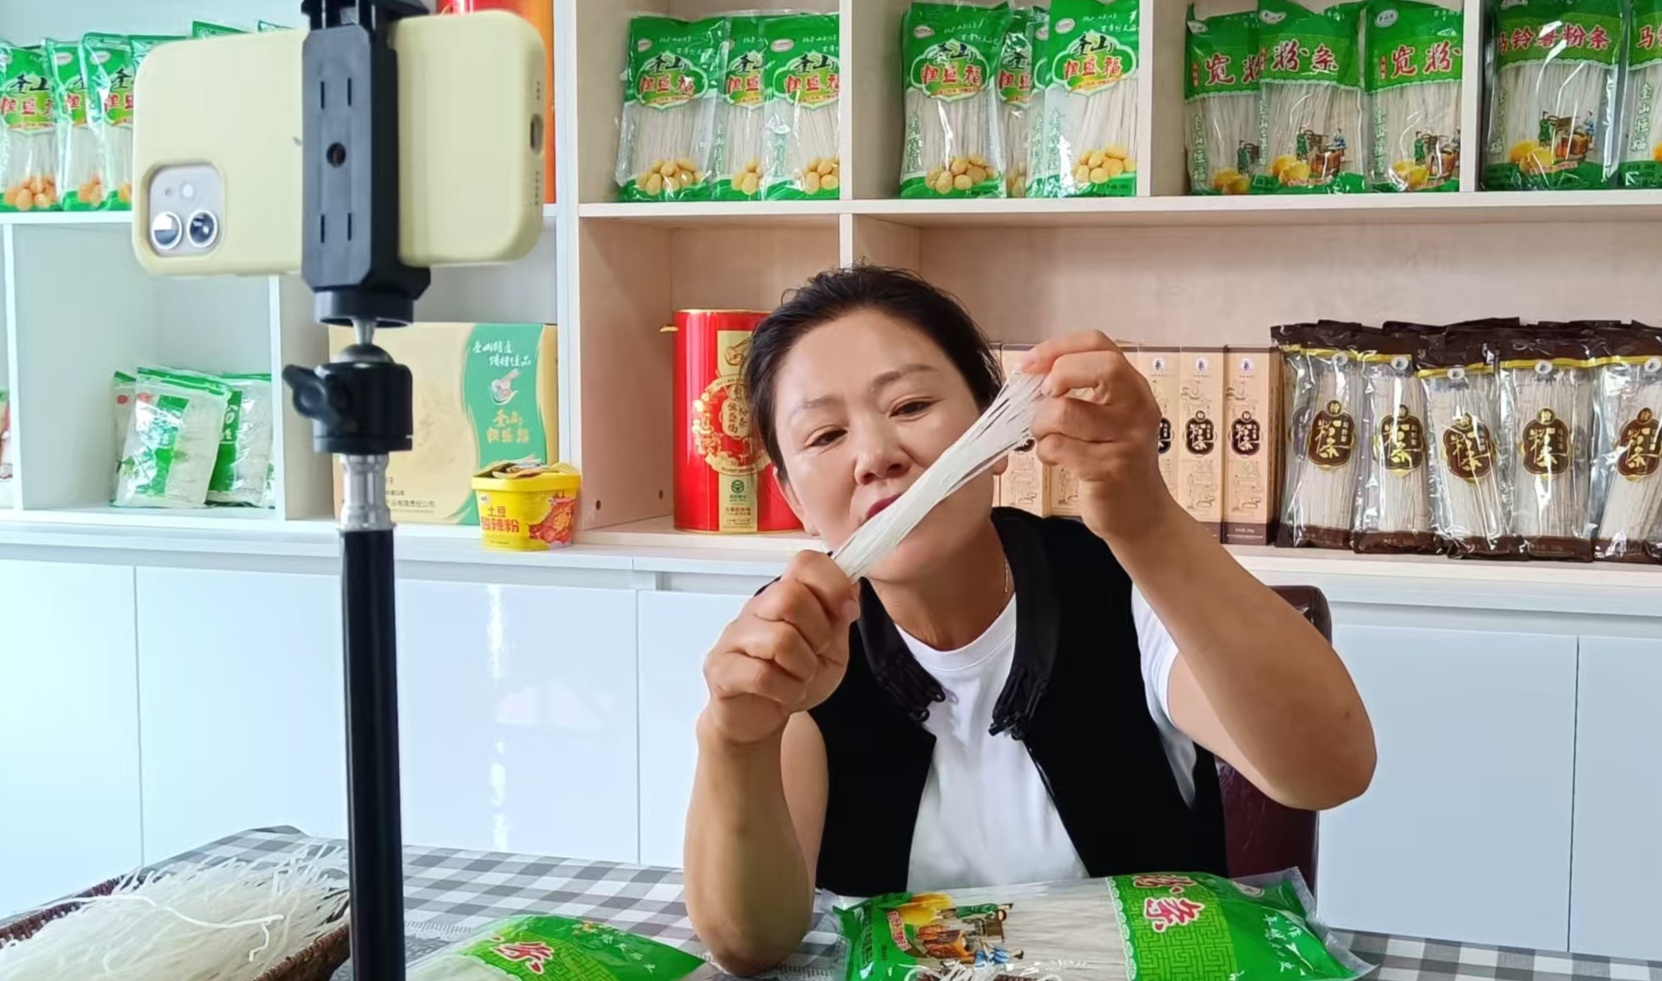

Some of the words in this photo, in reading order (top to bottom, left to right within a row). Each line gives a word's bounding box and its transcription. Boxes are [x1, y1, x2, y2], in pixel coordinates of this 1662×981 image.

[1635, 25, 1662, 50] 马
[1271, 38, 1338, 71] 粉条
[1391, 40, 1462, 78] 宽粉
[487, 506, 506, 517] 土豆
[481, 517, 520, 532] 酸辣粉
